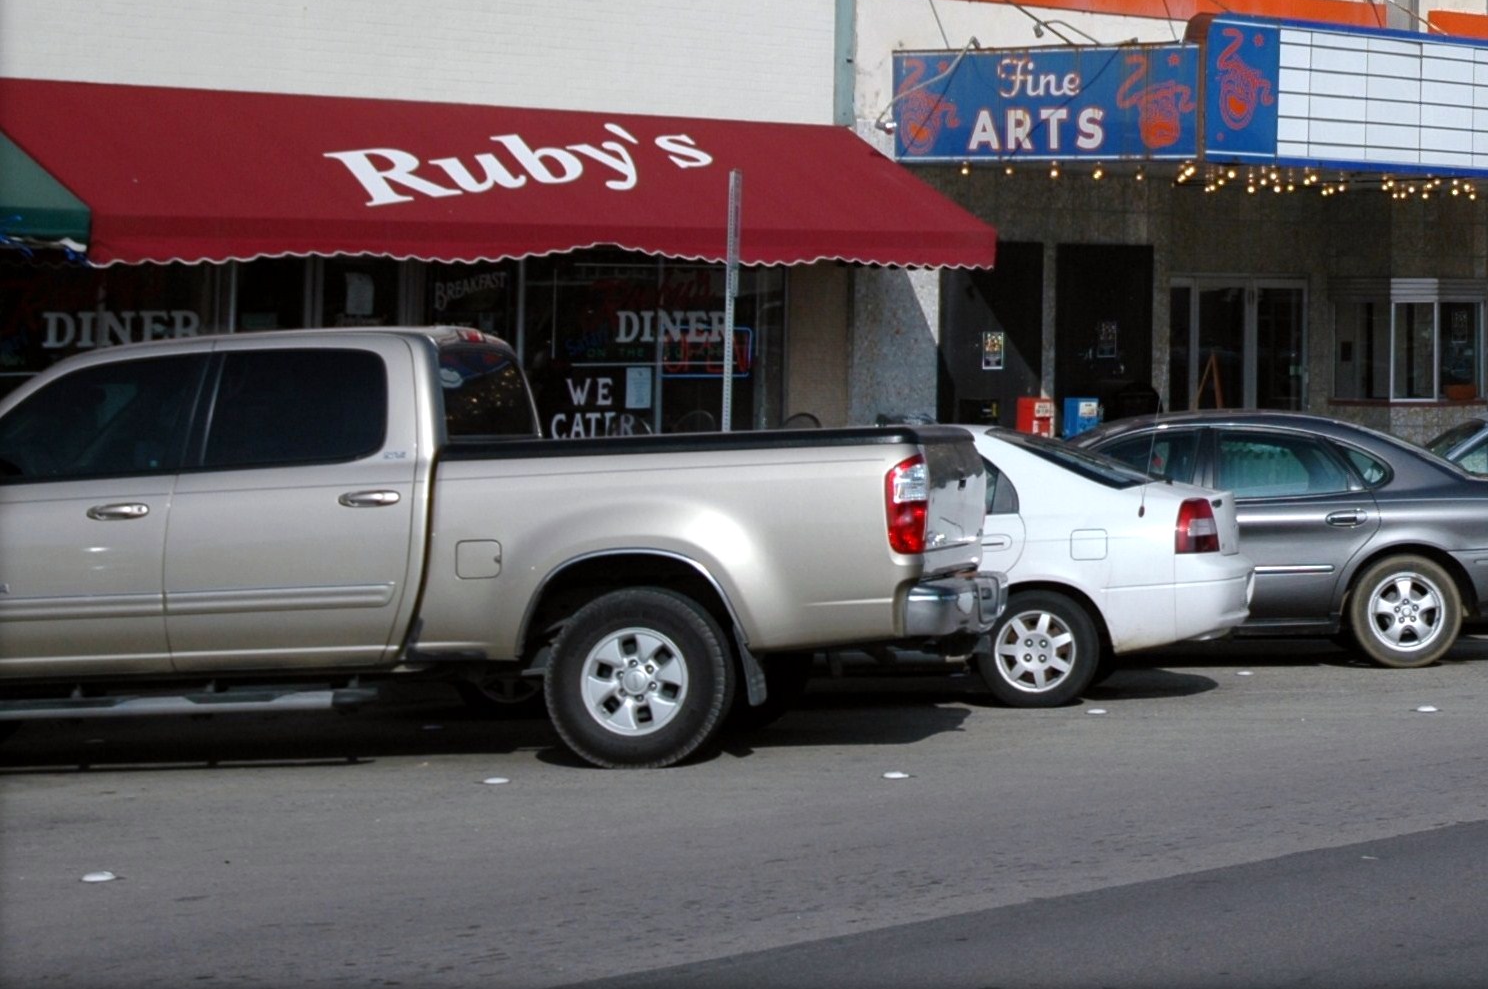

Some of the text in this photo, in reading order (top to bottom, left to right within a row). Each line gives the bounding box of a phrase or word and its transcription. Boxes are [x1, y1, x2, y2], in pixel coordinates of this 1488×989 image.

[997, 55, 1081, 99] Fine
[967, 106, 1105, 151] ARTS
[322, 123, 714, 207] Ruby's
[434, 271, 508, 311] BREAKFAST
[41, 311, 201, 349] DINER
[615, 311, 727, 343] DINER
[565, 377, 614, 406] WE
